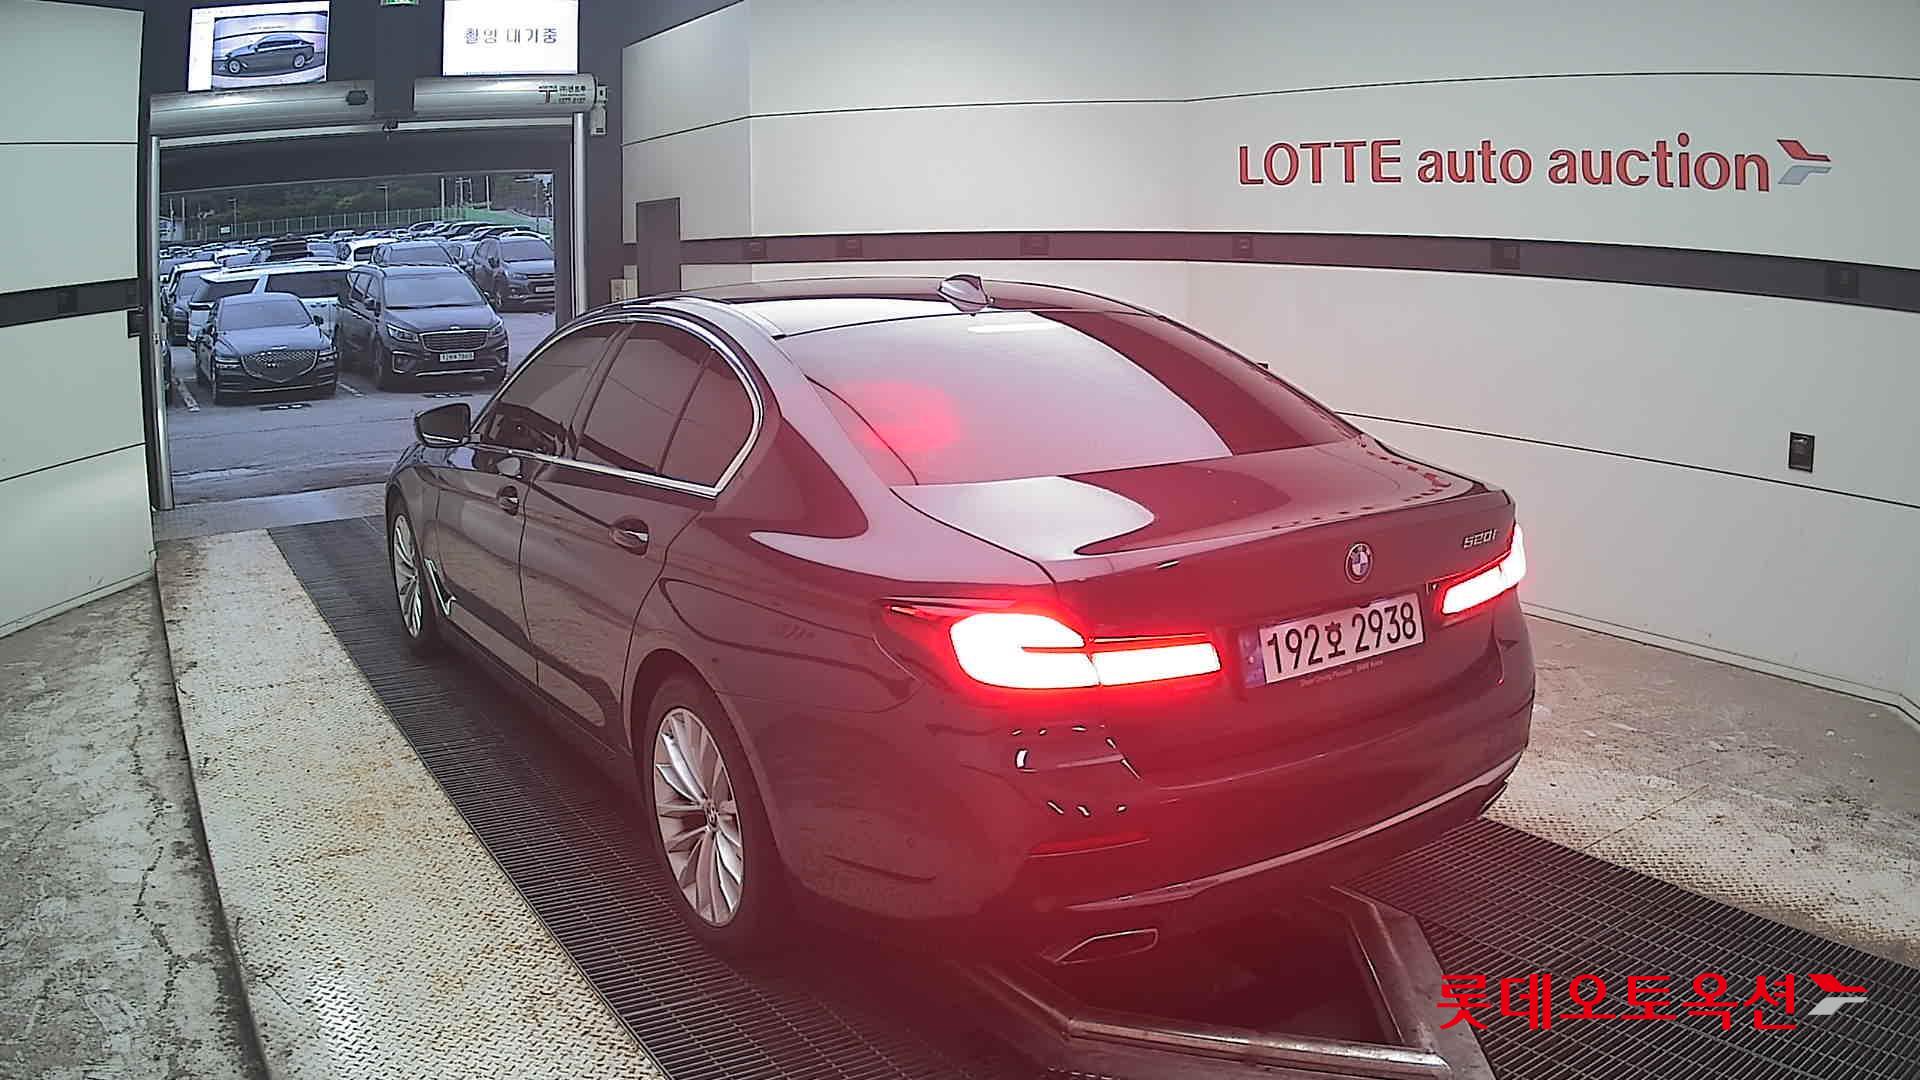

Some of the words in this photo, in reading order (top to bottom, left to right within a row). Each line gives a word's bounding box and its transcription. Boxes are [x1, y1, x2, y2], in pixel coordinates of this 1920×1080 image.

[1238, 138, 1402, 186] LOTTE
[1417, 139, 1533, 185] auto
[1548, 132, 1770, 193] auction
[1463, 528, 1497, 549] 520i
[1266, 620, 1346, 674] 192호
[1351, 601, 1418, 655] 2938
